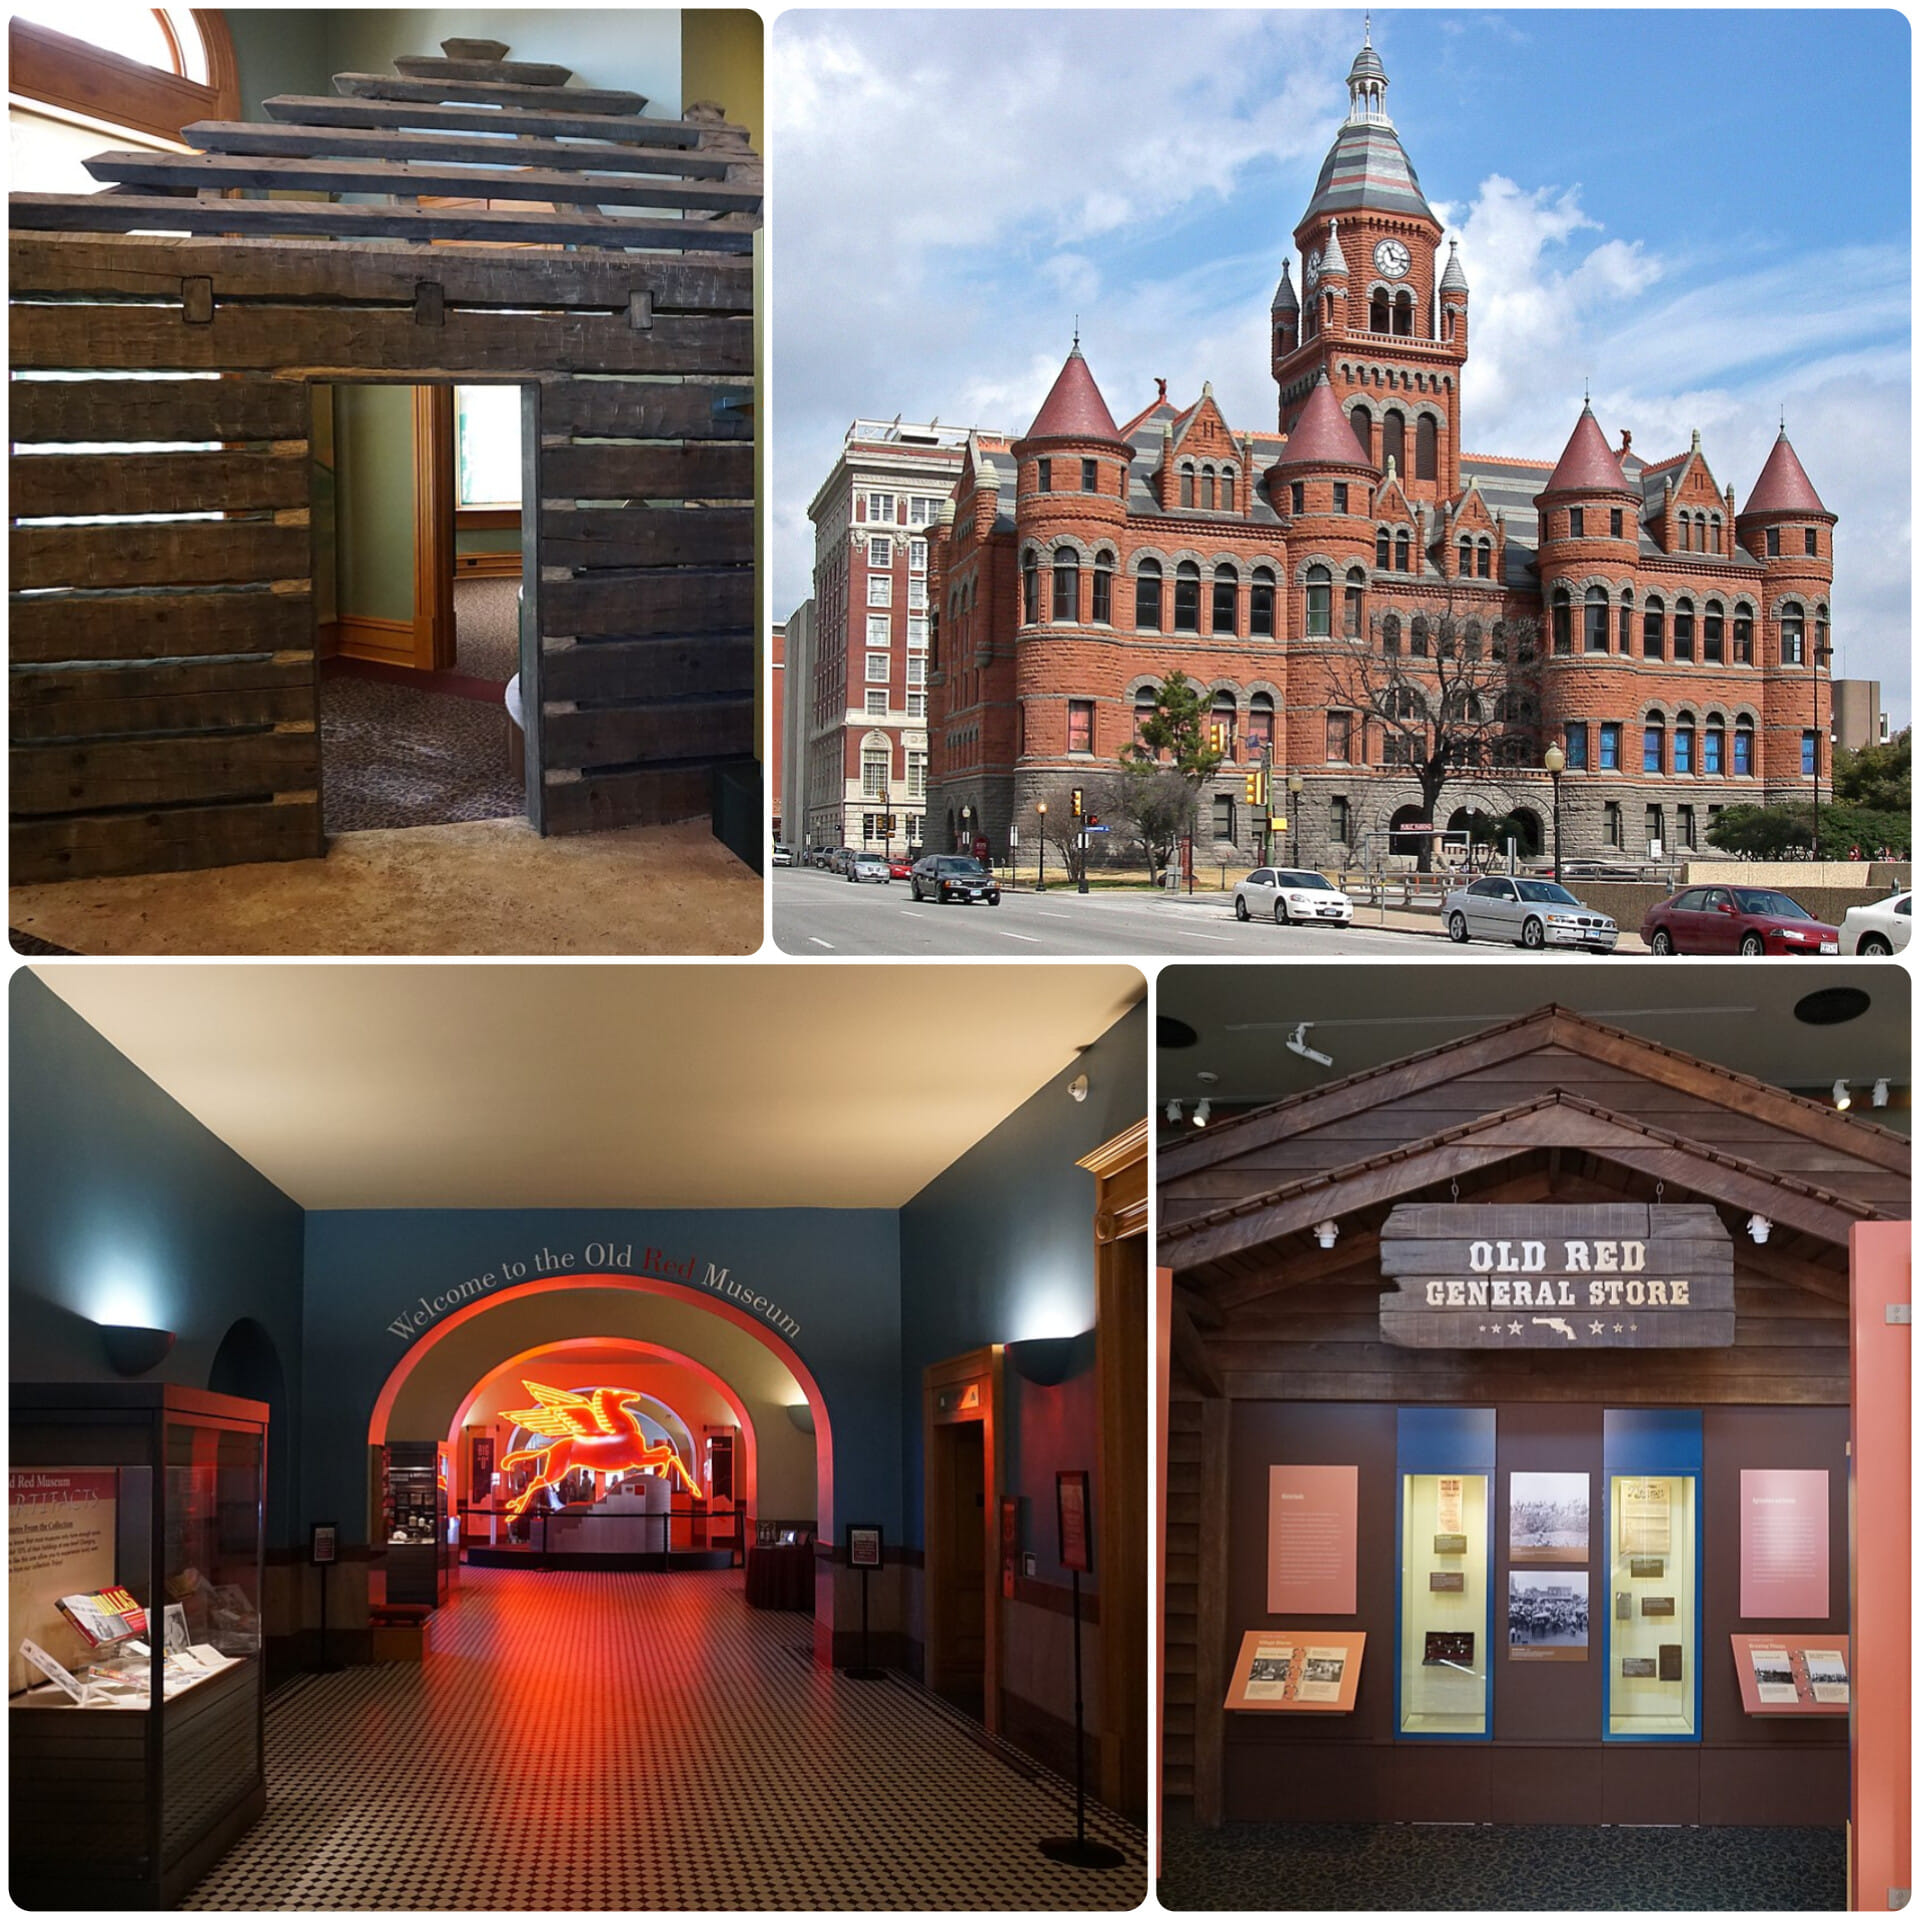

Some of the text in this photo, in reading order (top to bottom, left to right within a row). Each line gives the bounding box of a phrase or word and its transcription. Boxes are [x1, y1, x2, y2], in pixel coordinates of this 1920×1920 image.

[1469, 1241, 1646, 1272] OLD RED
[387, 1242, 801, 1341] Welcome to the Old Red Museum
[1425, 1280, 1690, 1306] GENERAL STORE
[17, 1474, 35, 1489] Red
[37, 1474, 71, 1489] Museum
[14, 1488, 99, 1518] RTIFACTS
